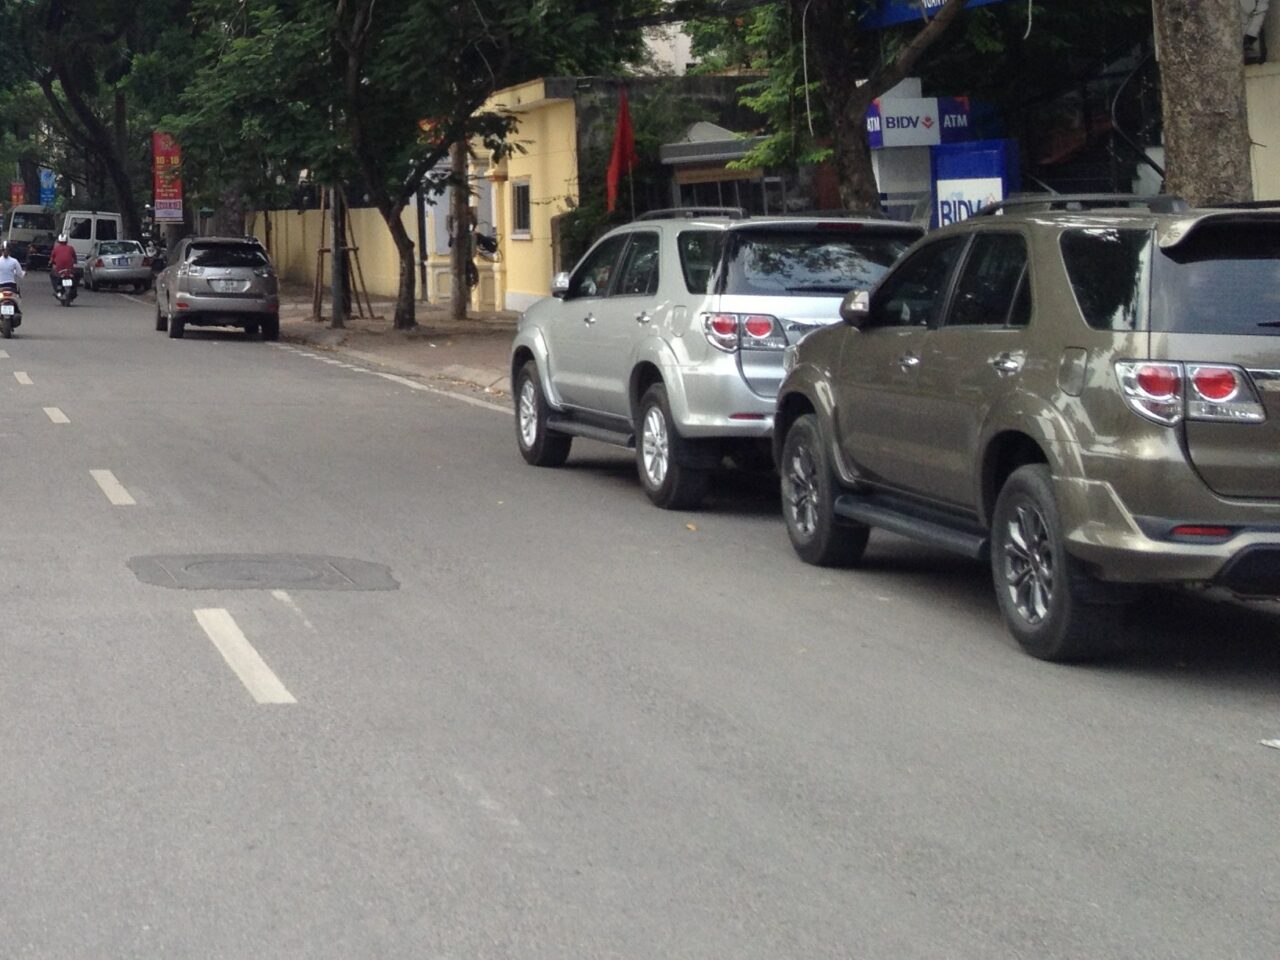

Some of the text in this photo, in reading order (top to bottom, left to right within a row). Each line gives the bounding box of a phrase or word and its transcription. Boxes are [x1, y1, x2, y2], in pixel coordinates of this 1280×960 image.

[867, 117, 880, 132] ATM
[886, 116, 919, 129] BIDV
[943, 115, 968, 128] ATM
[940, 200, 981, 227] BIDV
